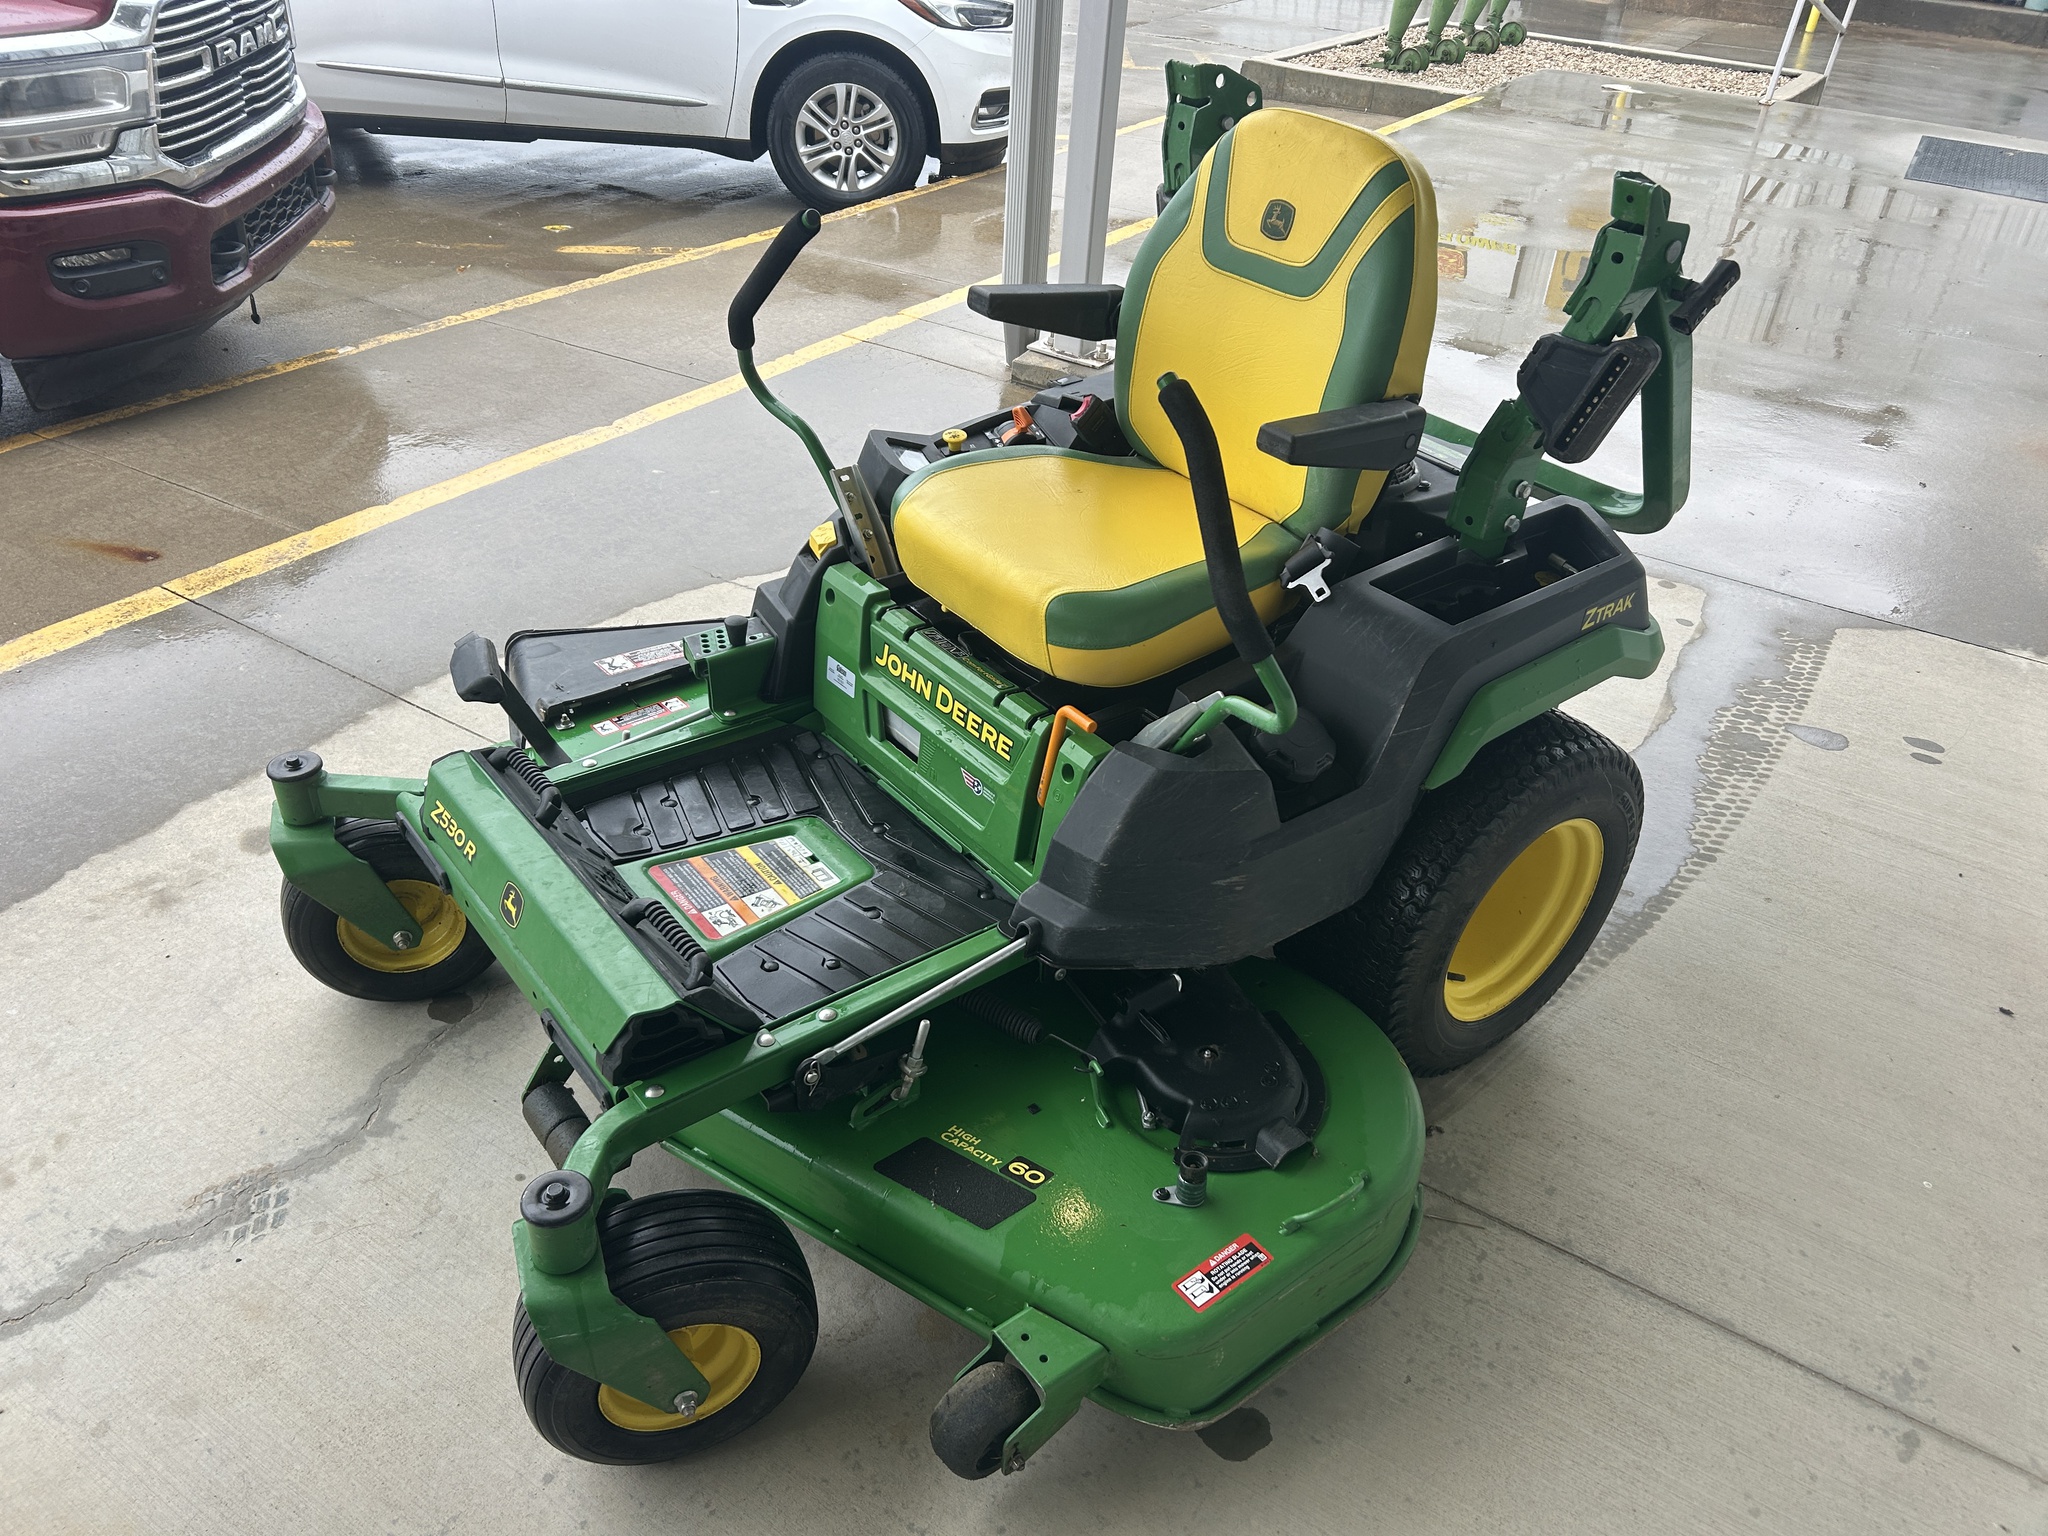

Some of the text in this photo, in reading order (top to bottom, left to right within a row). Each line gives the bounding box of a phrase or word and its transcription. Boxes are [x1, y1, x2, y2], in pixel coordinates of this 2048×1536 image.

[215, 20, 278, 66] RAM
[1581, 592, 1635, 630] ZTRAK
[875, 643, 932, 701] JOHN
[935, 683, 1013, 761] DEERE
[941, 1132, 1003, 1166] CAPACITY
[947, 1125, 981, 1145] HIGH
[1008, 1161, 1046, 1184] 60
[1210, 1247, 1248, 1275] ROTATING BLADE
[1213, 1242, 1240, 1262] DANGER
